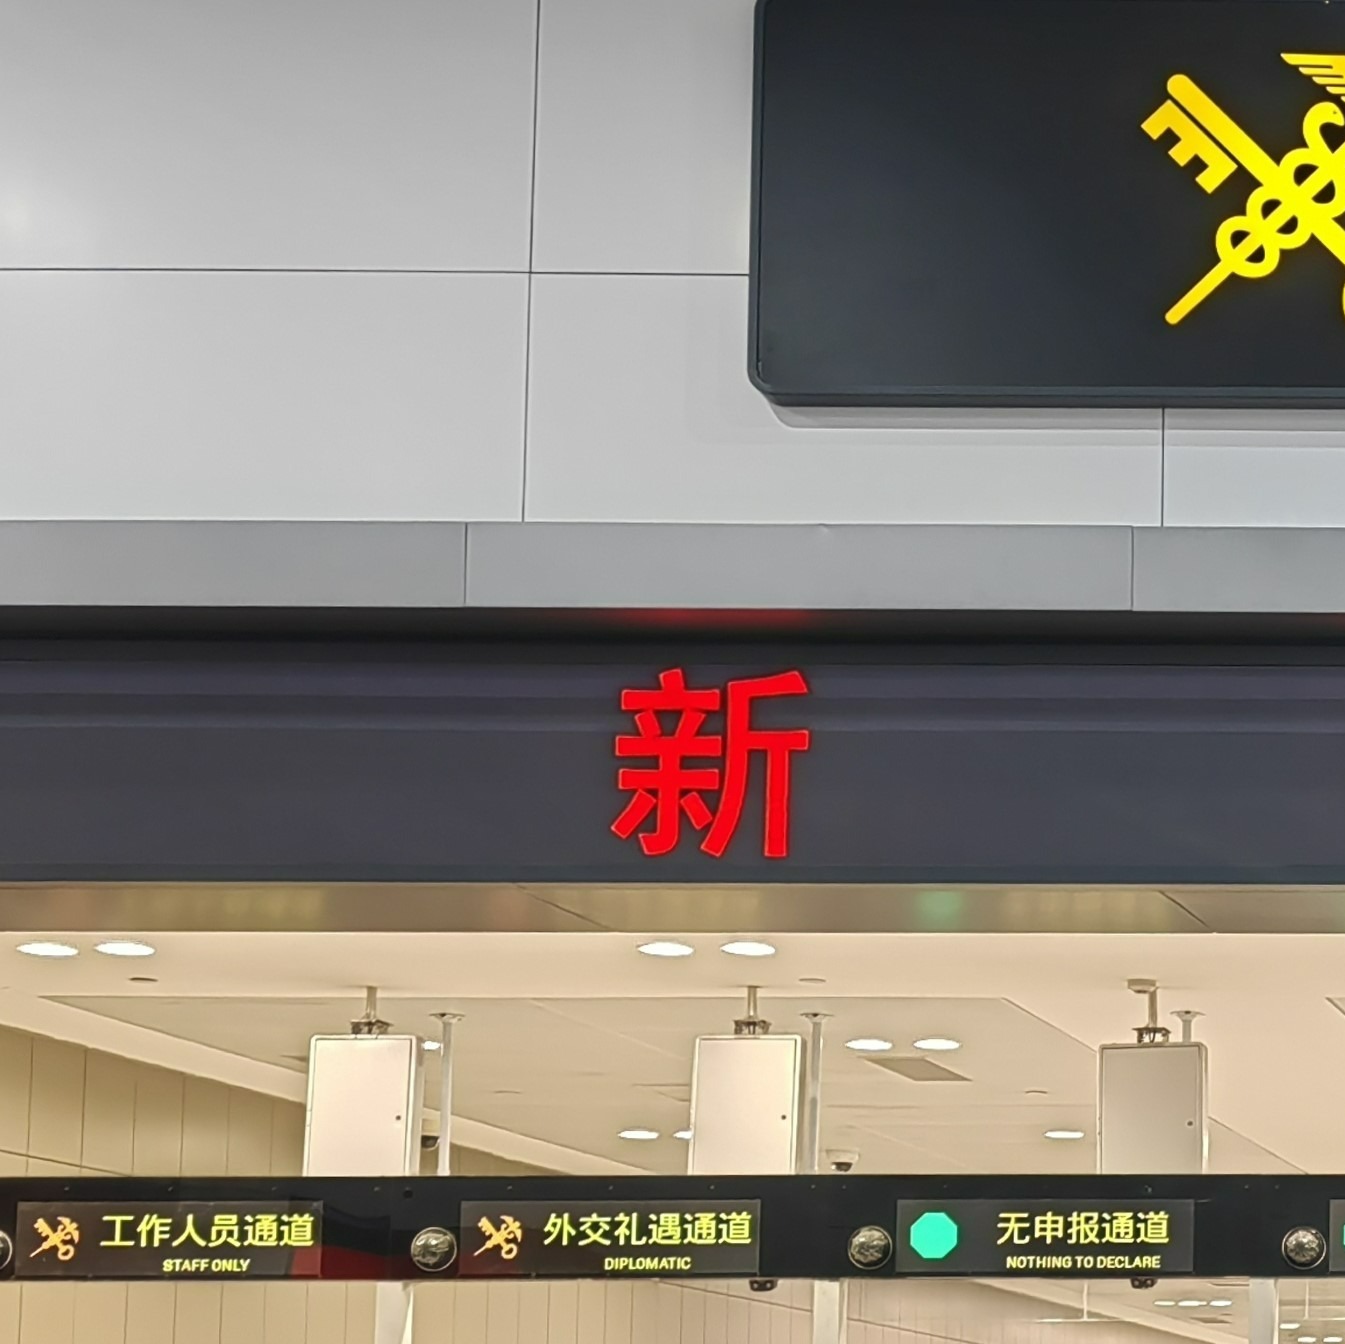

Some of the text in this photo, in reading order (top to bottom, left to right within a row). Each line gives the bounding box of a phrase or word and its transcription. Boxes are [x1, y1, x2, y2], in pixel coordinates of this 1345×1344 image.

[100, 1212, 315, 1248] 工作人员通道
[544, 1210, 753, 1246] 外交礼遇通道
[998, 1211, 1170, 1245] 无申报通道
[162, 1259, 250, 1273] STAFF ONLY
[604, 1256, 692, 1271] DIPLOMATIC
[1006, 1256, 1161, 1269] NOTHING TO DECLARE
